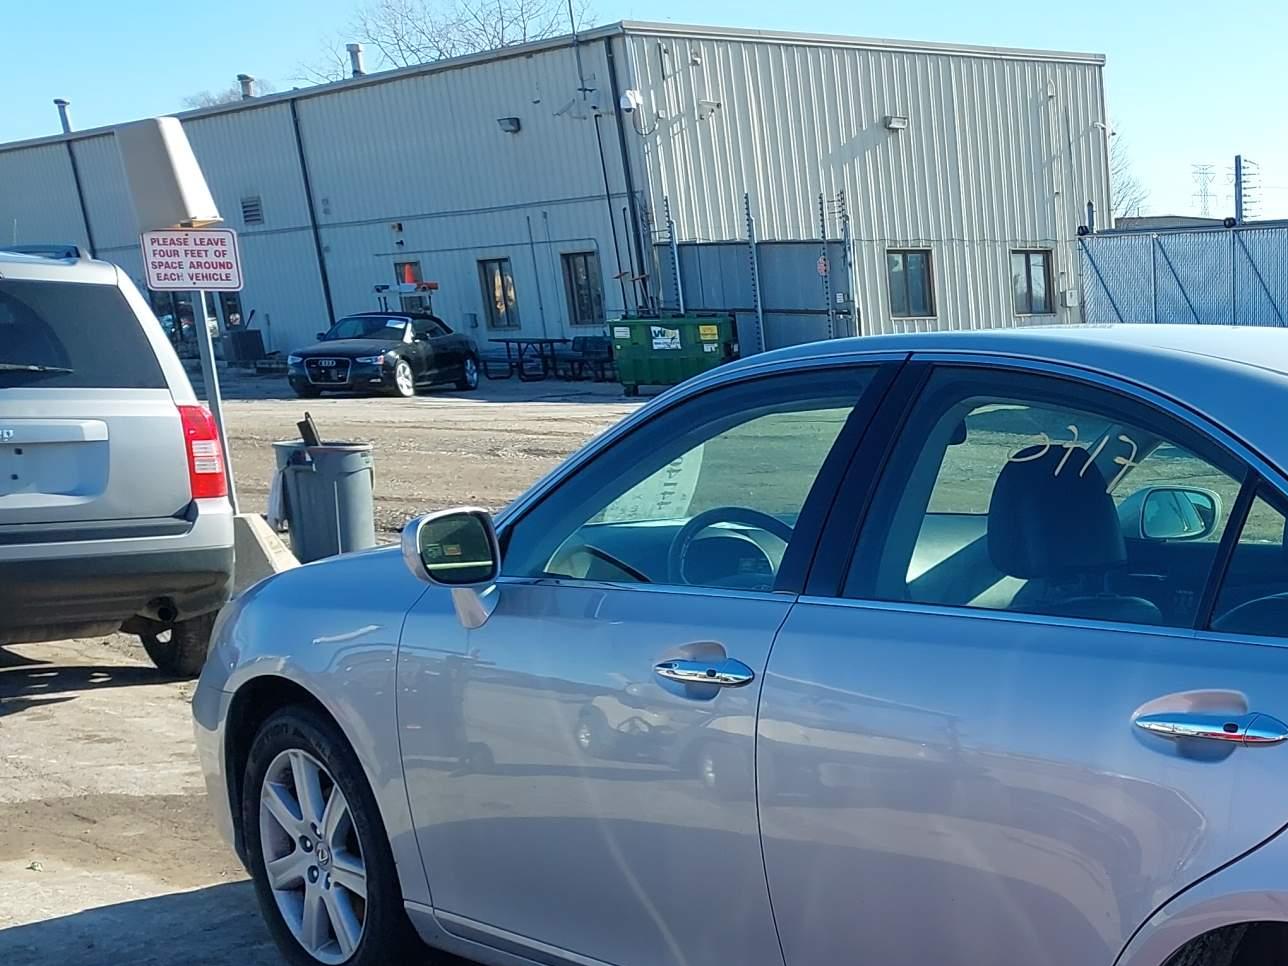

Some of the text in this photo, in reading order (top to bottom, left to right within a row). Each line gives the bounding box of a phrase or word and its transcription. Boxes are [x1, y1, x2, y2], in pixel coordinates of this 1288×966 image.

[150, 238, 227, 246] PLEASE LEAVE
[152, 249, 228, 258] FOUR FEET OF
[151, 261, 233, 270] SPACE AROUND
[156, 273, 233, 281] EACH VEHICLE
[1007, 425, 1139, 494] 0717
